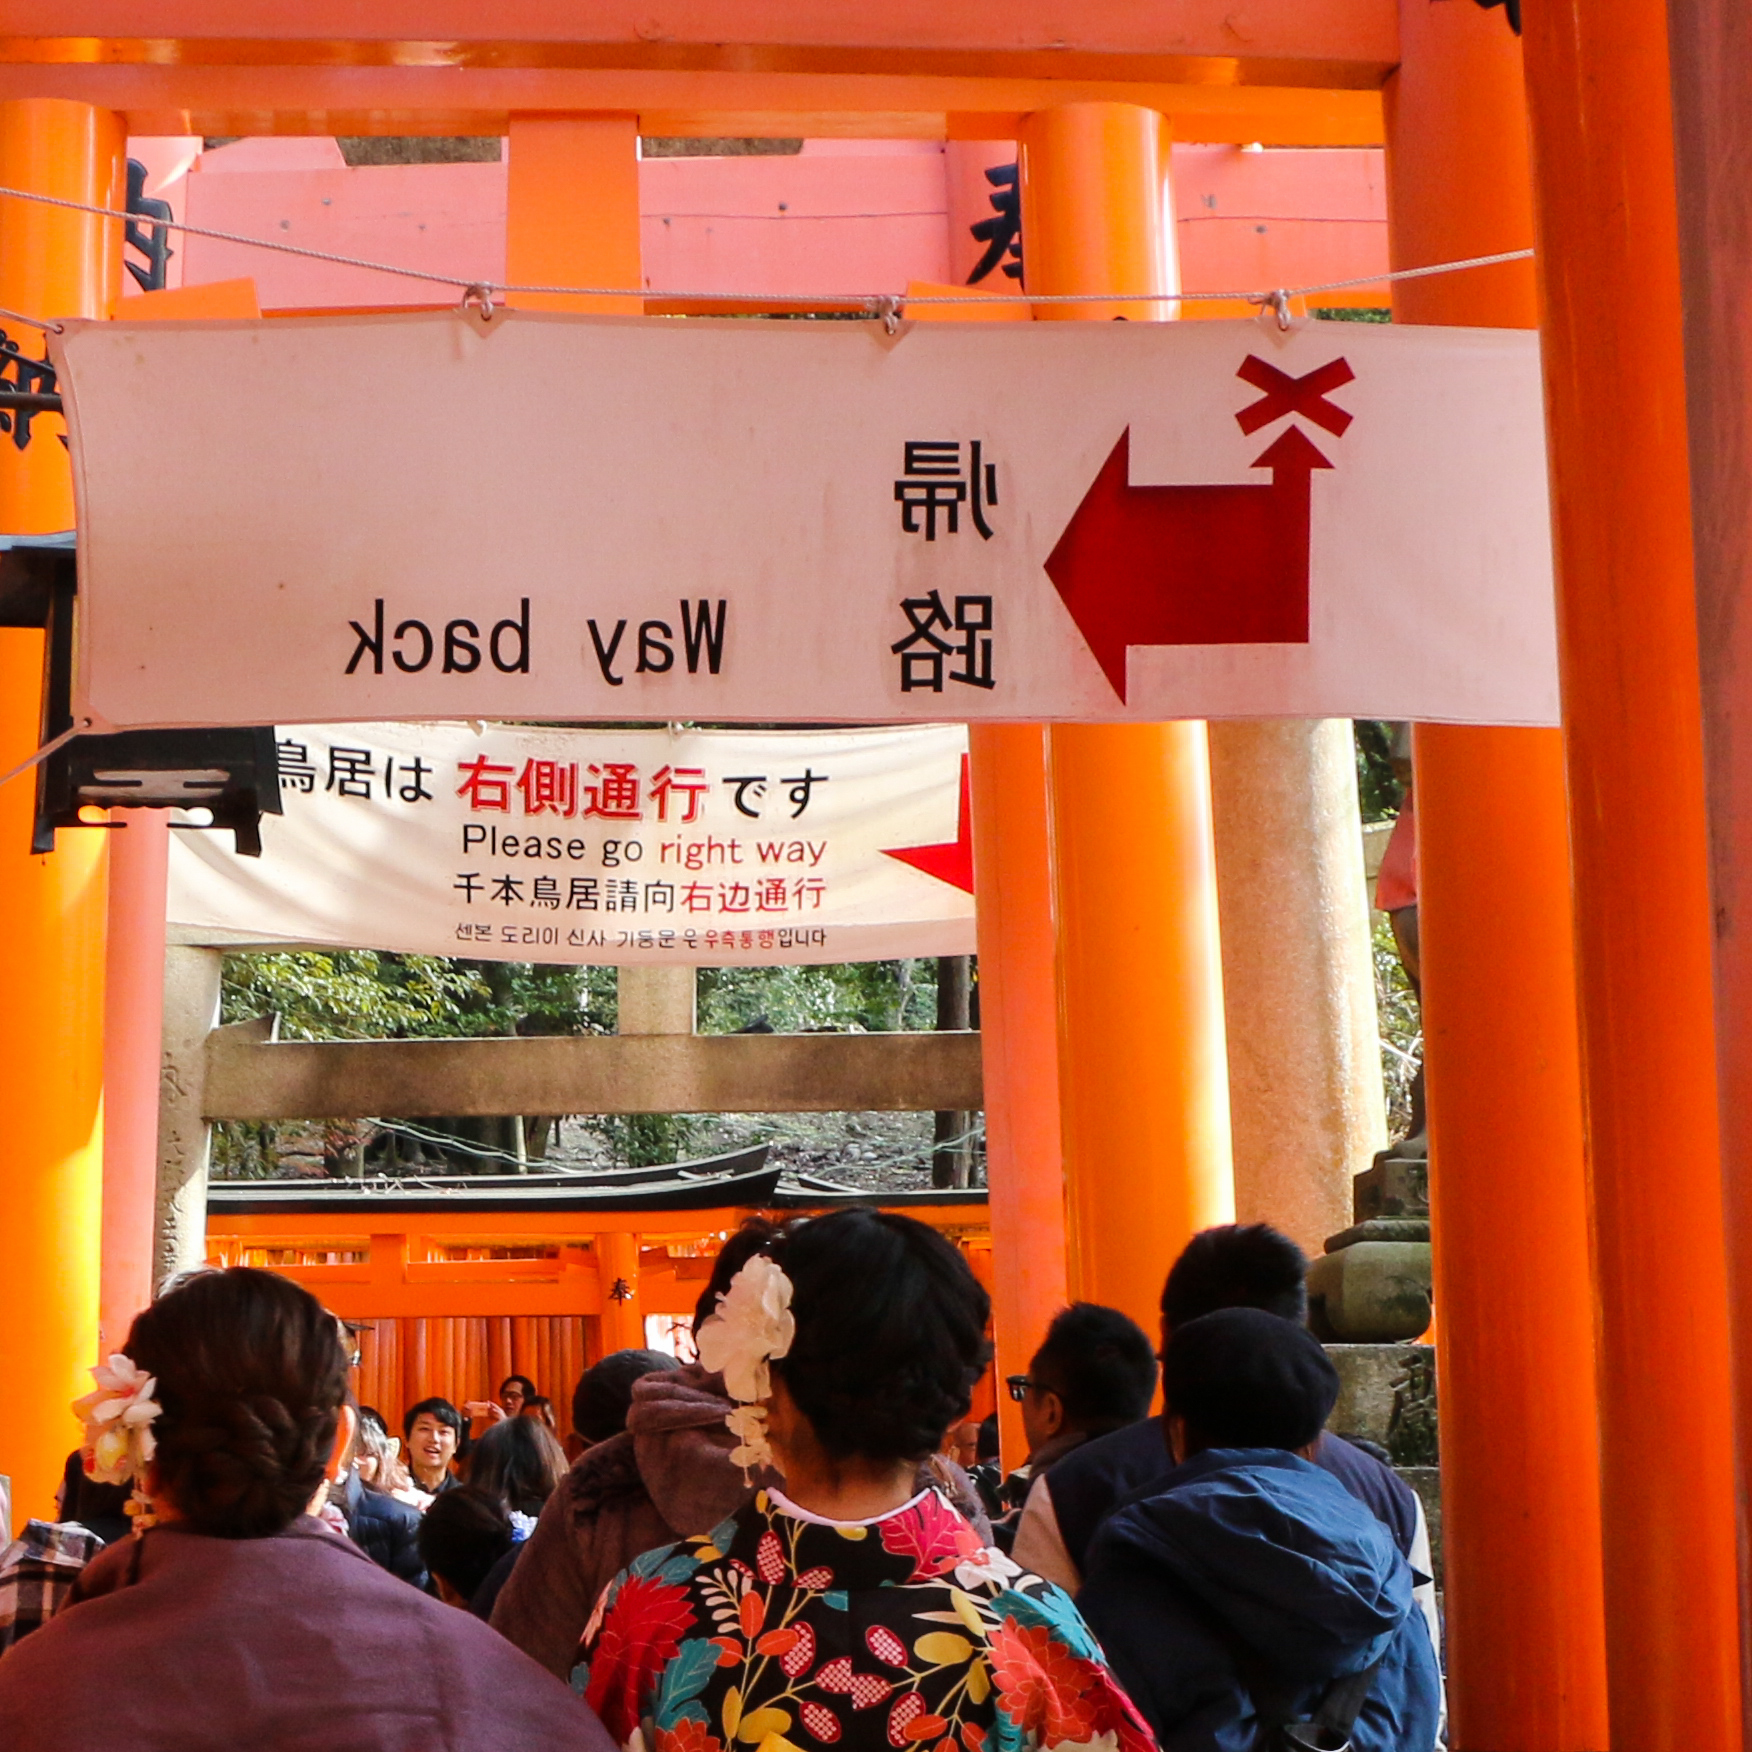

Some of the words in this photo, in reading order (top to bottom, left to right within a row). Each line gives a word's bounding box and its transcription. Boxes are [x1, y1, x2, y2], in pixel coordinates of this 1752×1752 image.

[462, 823, 586, 860] Please
[602, 837, 643, 868] go
[660, 833, 743, 871] right
[756, 840, 828, 867] way
[455, 922, 493, 943] 센본
[500, 925, 559, 945] 도리이
[566, 928, 607, 948] 신사
